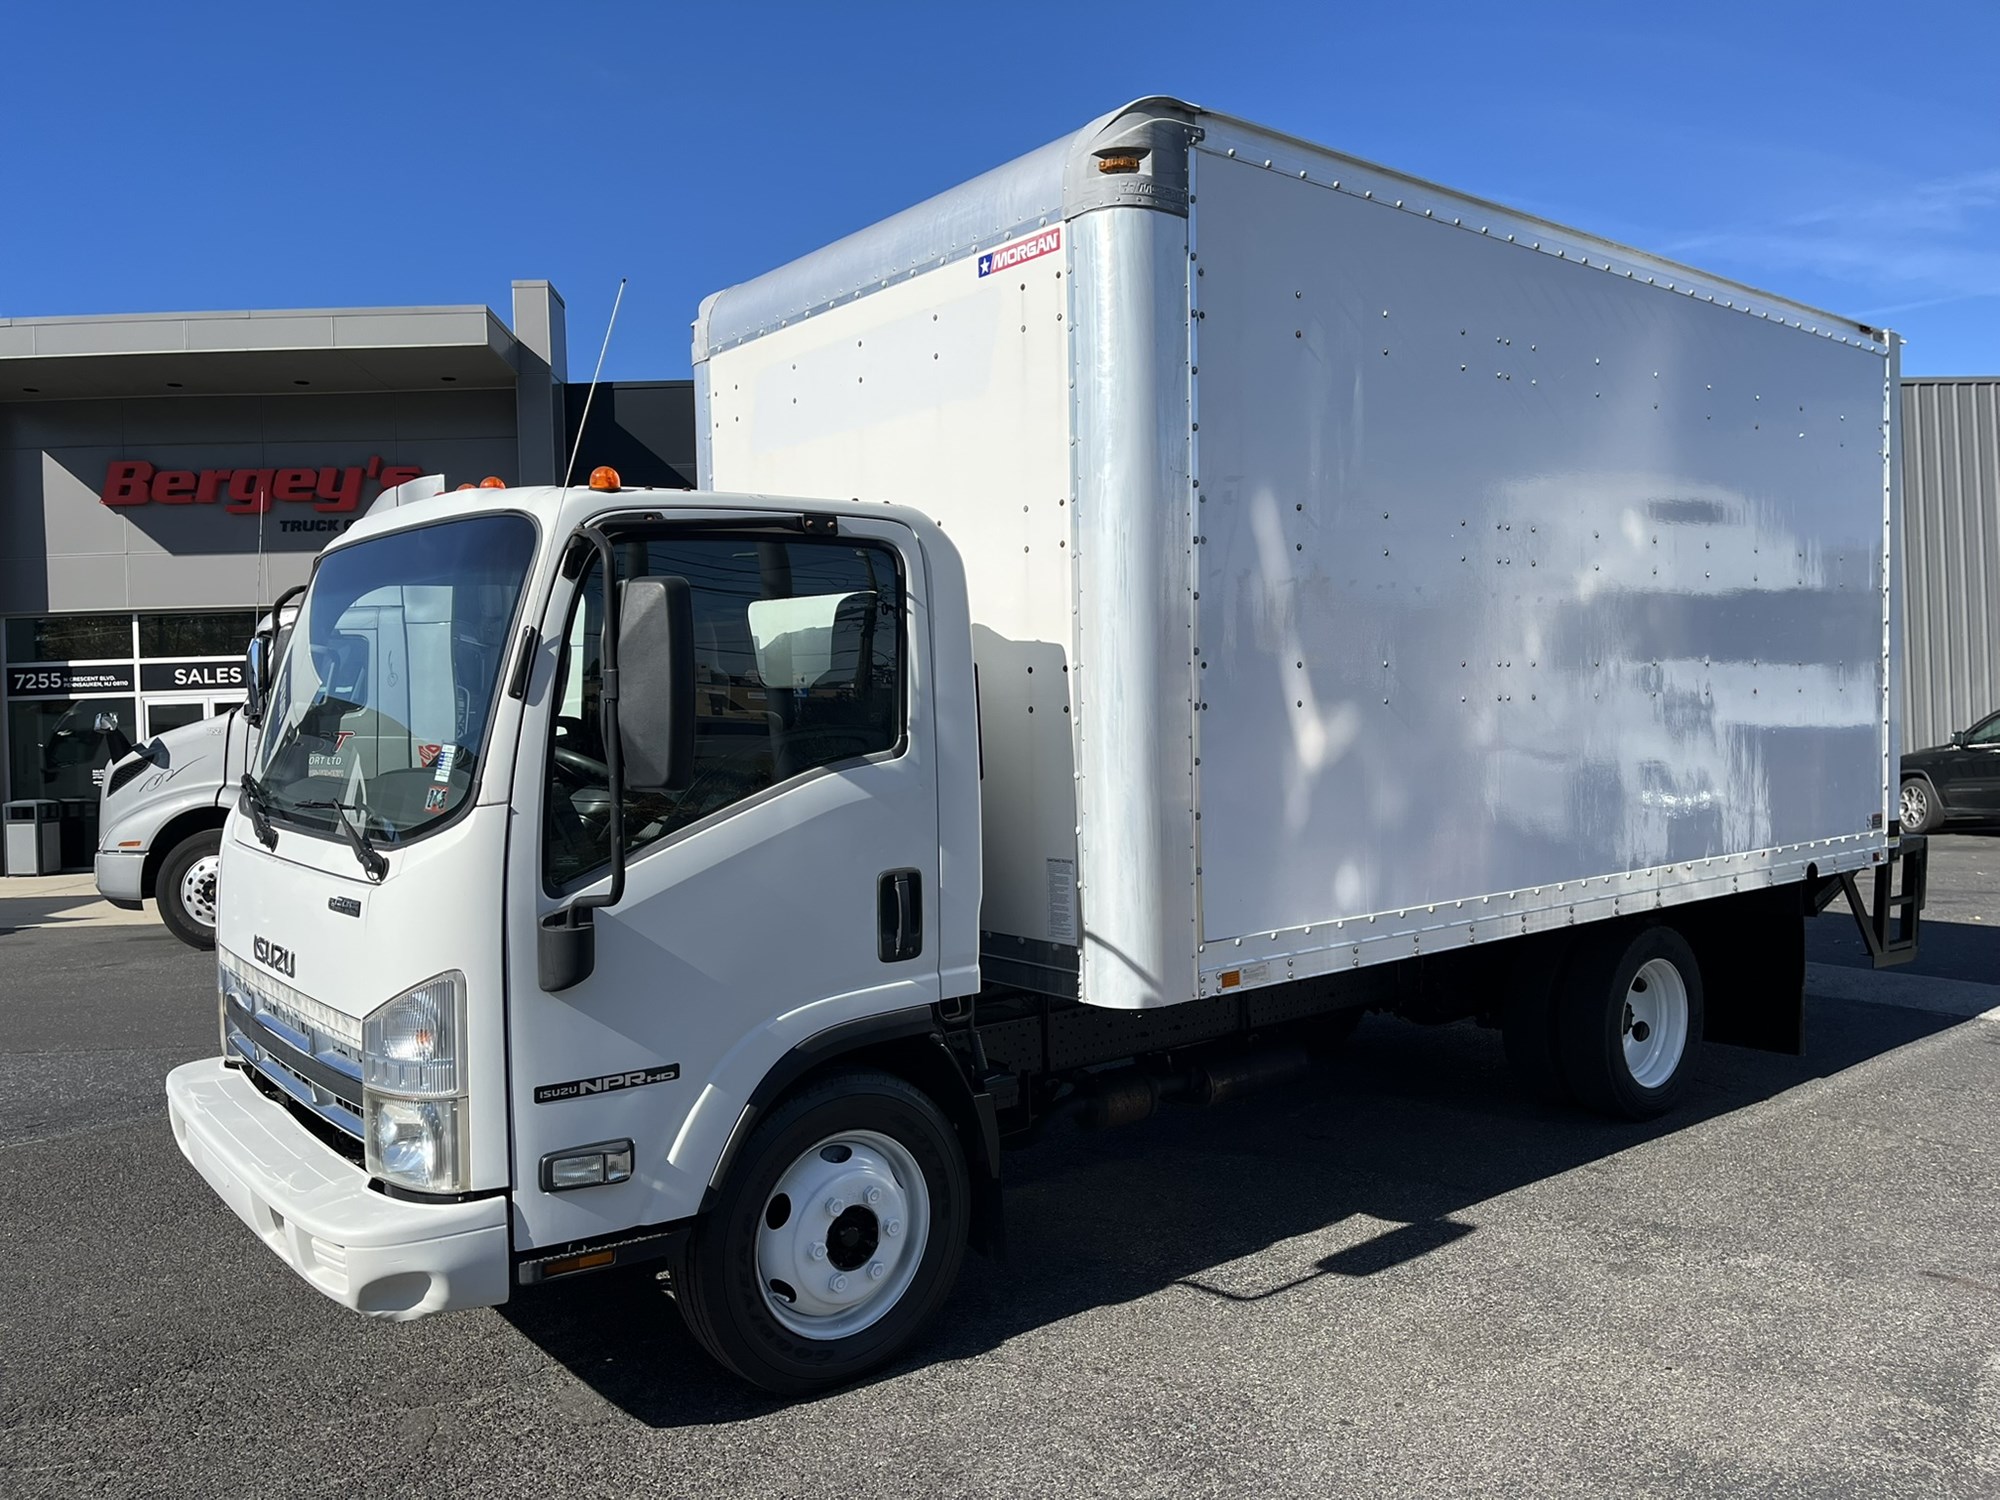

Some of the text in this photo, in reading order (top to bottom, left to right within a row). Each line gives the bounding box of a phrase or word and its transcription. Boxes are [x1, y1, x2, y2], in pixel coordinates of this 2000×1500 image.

[992, 232, 1058, 271] MORGAN
[280, 519, 340, 532] TRUCK
[14, 673, 61, 690] 7255
[174, 667, 243, 685] SALES
[253, 933, 296, 978] ISUZU
[539, 1071, 676, 1099] ISUZU NPR HD
